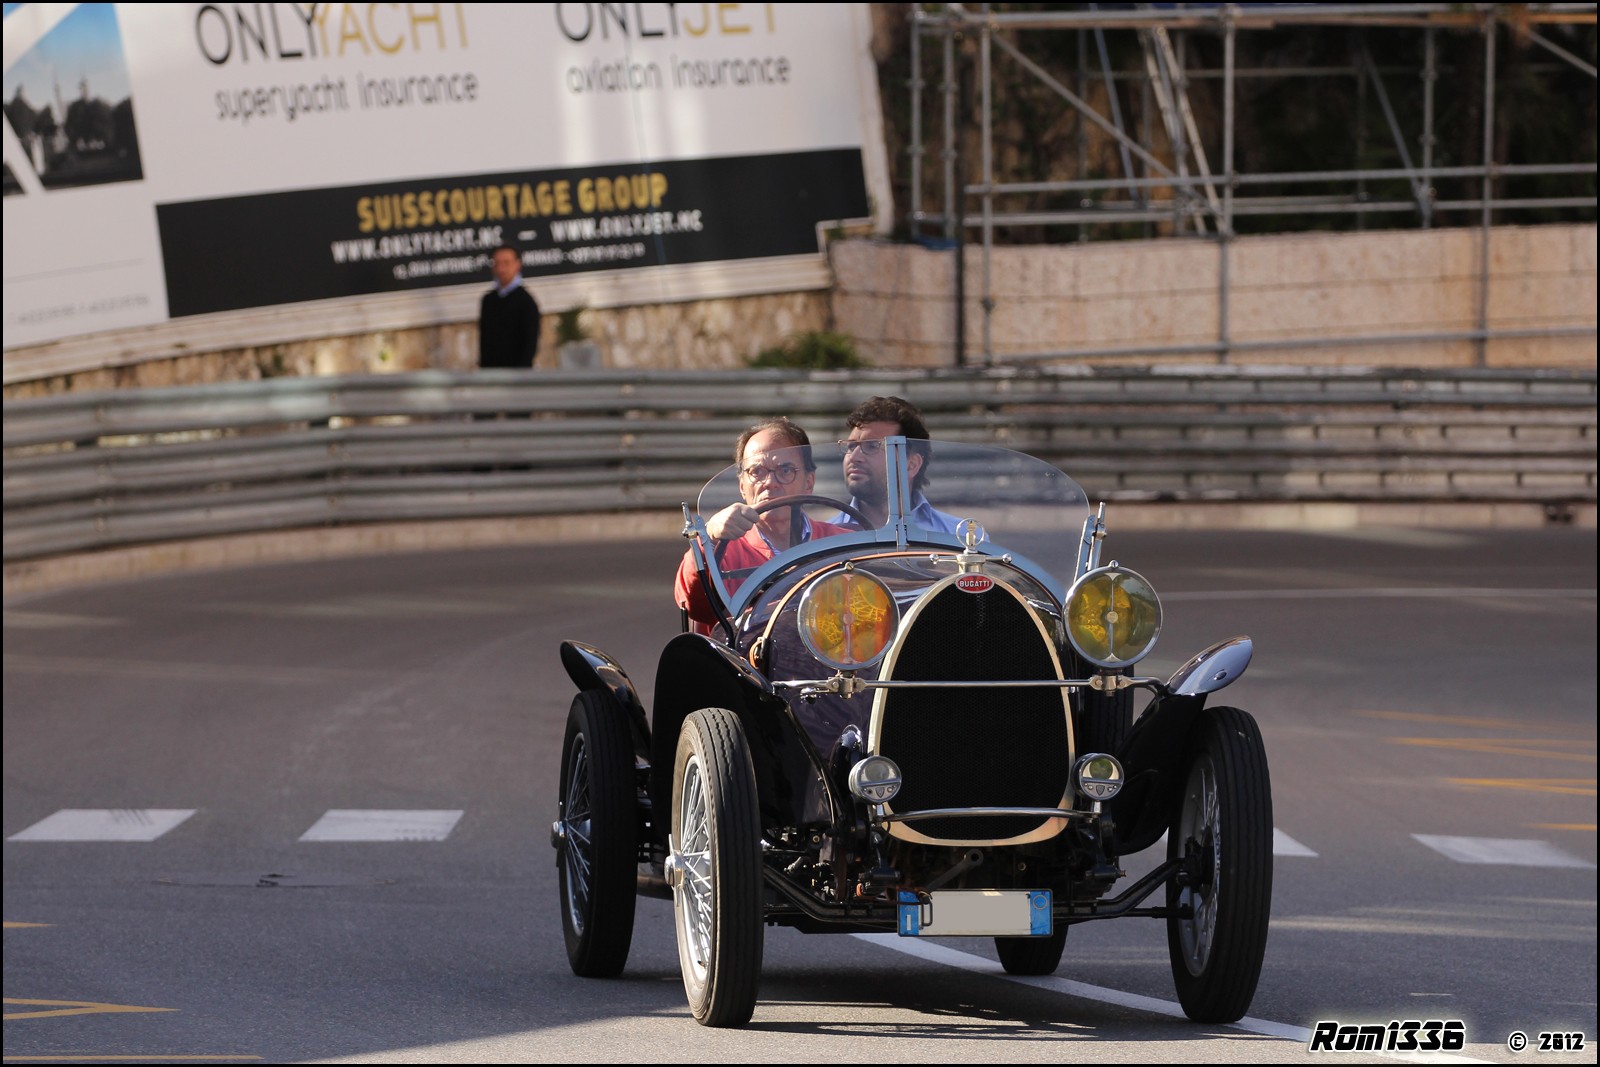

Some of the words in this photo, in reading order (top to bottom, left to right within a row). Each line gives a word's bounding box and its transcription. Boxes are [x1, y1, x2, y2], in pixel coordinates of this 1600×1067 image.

[566, 57, 662, 93] aviation
[671, 55, 791, 88] insurance
[215, 76, 348, 122] superyacht
[357, 73, 477, 109] insurance
[357, 178, 572, 233] SUISSCOURTAGE
[577, 172, 667, 213] GROUP
[959, 580, 990, 588] BUGATTI
